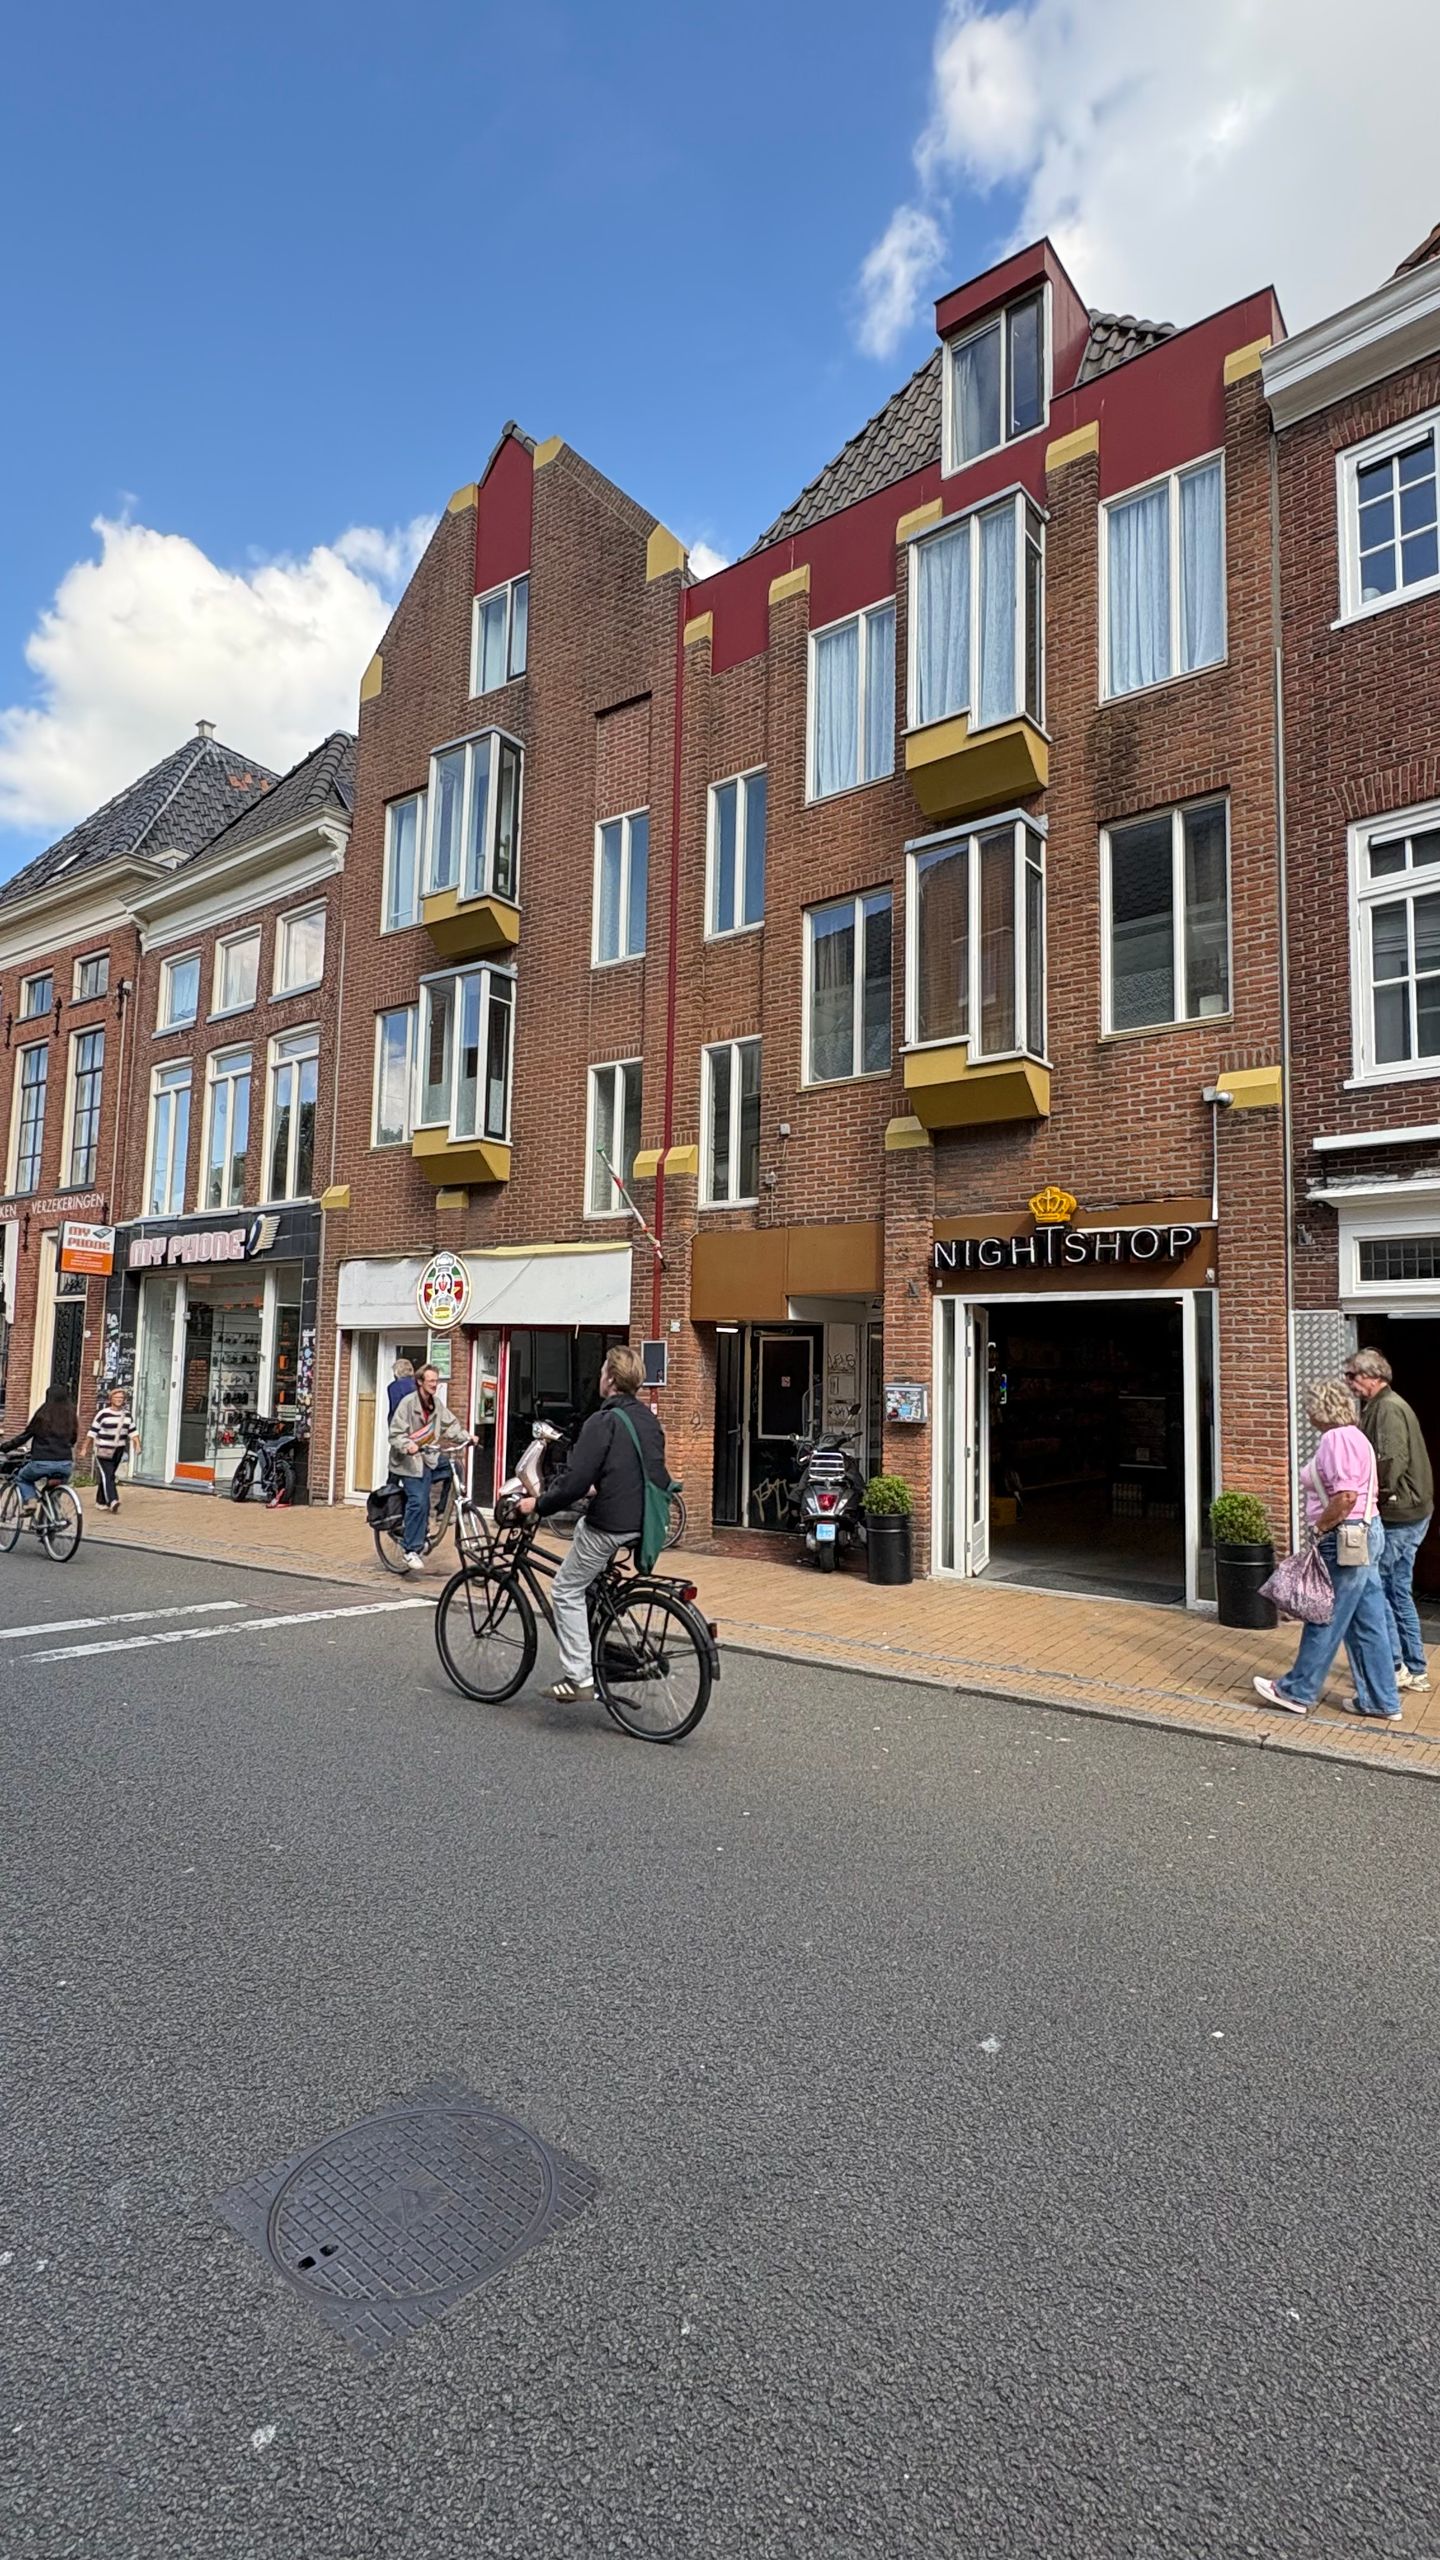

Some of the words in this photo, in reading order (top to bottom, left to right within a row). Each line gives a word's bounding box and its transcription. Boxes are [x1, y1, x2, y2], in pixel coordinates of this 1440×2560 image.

[31, 1192, 105, 1215] VERZEKERINGEN
[68, 1225, 91, 1237] MY
[934, 1225, 1194, 1268] NIGHTSHOP
[129, 1237, 168, 1268] MY
[167, 1228, 247, 1265] PHONE
